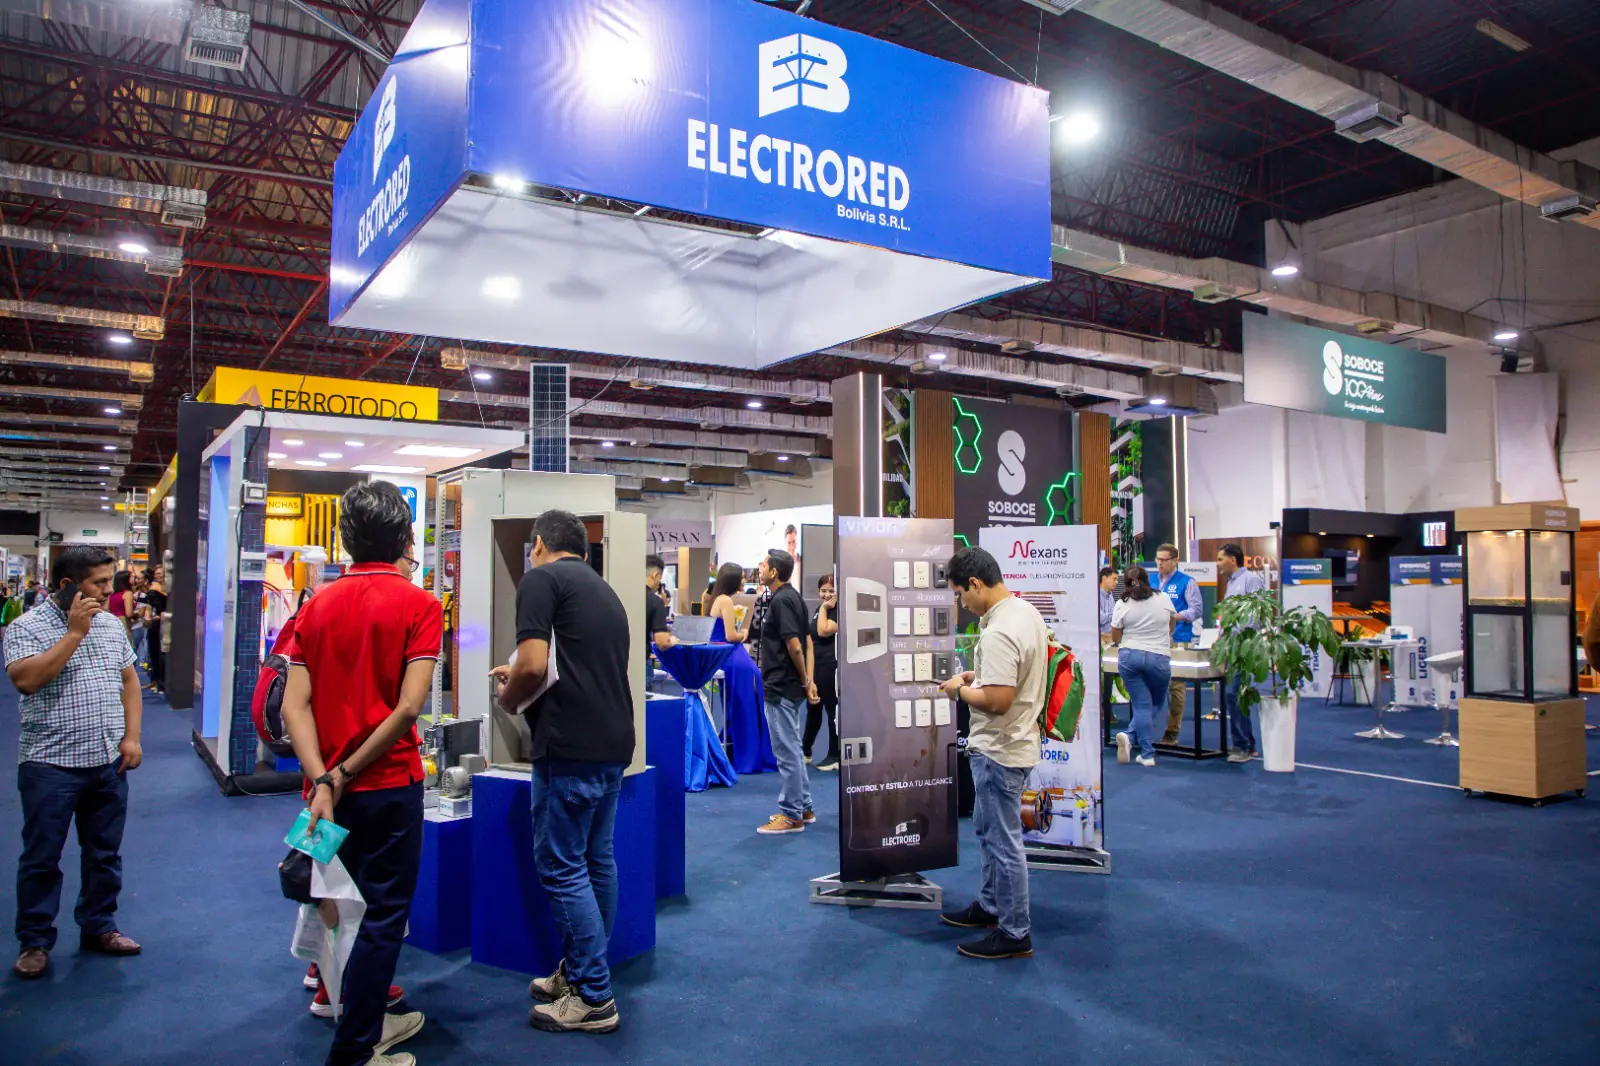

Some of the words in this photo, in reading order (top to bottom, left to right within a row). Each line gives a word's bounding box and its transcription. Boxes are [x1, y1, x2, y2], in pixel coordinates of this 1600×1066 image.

[687, 118, 910, 212] ELECTRORED
[358, 154, 411, 258] ELECTRORED
[837, 204, 876, 225] Bolivia
[878, 213, 911, 231] S.R.L.
[1344, 354, 1384, 375] SOBOCE
[271, 388, 418, 421] FERROTODO
[988, 500, 1036, 516] SOBOCE
[1008, 540, 1068, 559] Nexans
[846, 784, 879, 794] CONTROL
[886, 781, 908, 790] ESTILO
[924, 776, 953, 786] ALCANCE
[882, 834, 921, 847] ELECTRORED
